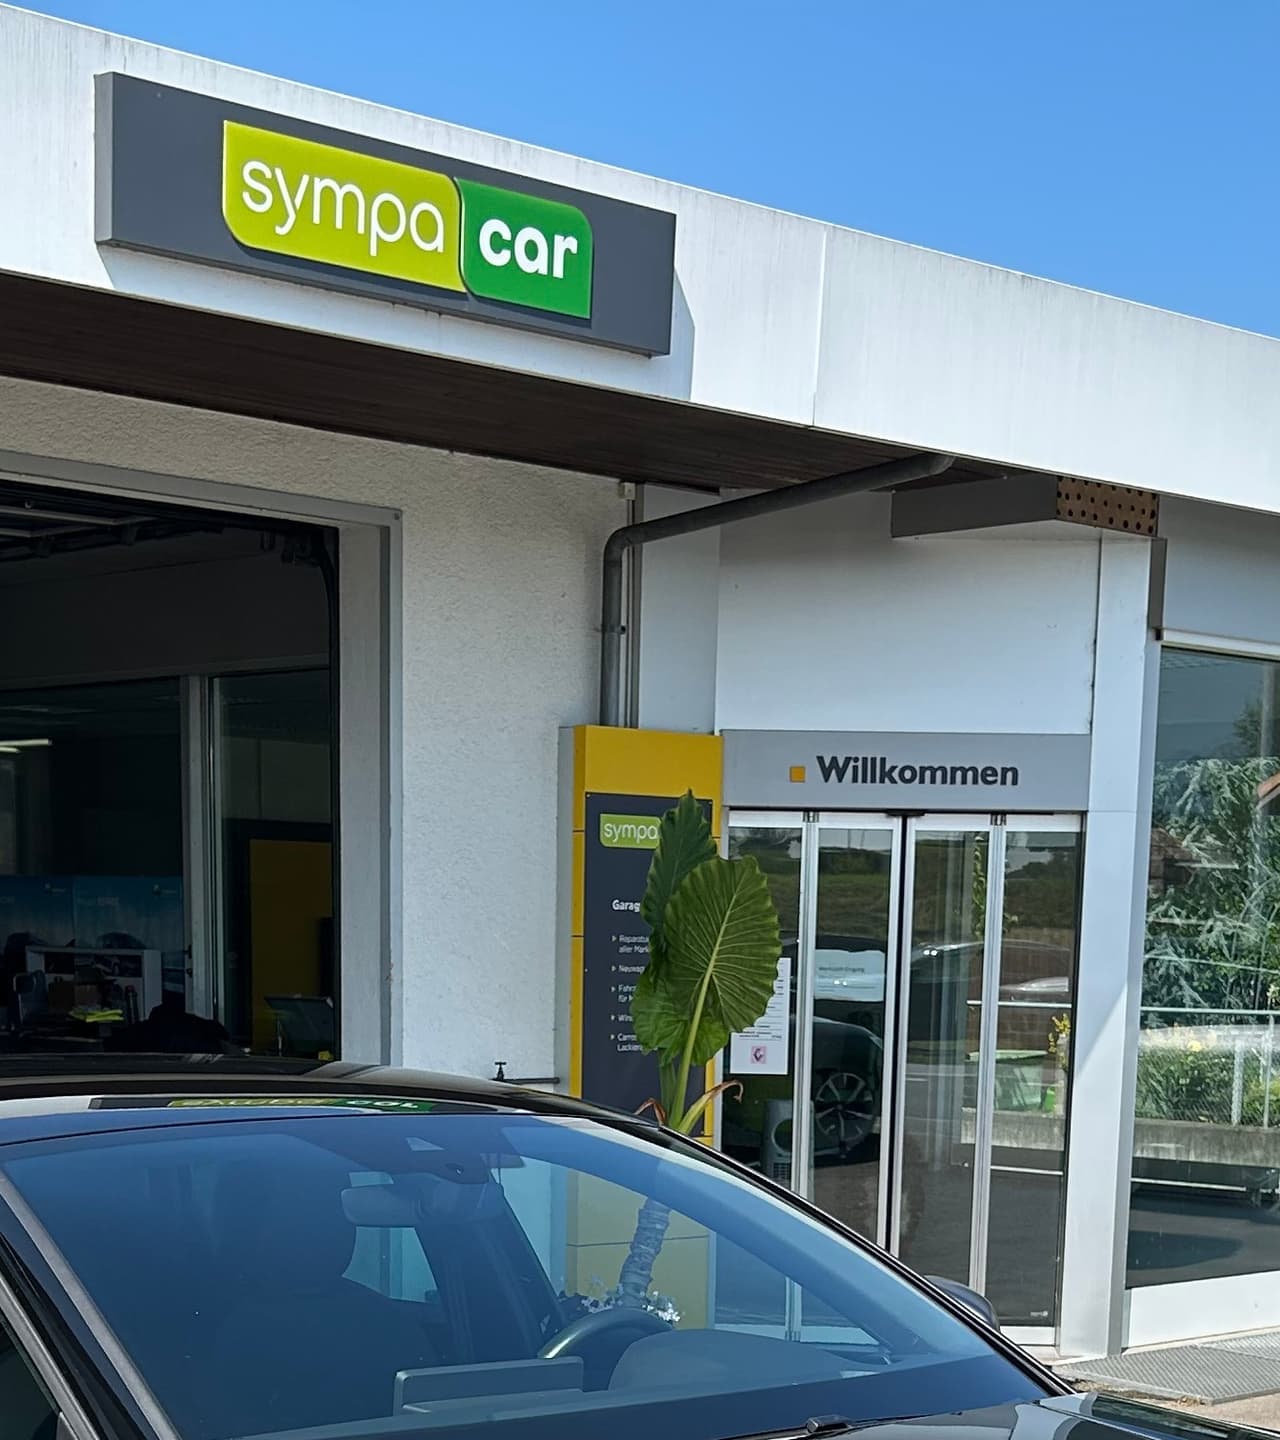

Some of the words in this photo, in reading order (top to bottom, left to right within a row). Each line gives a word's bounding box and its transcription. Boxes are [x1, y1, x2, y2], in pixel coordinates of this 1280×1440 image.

[241, 160, 445, 257] sympa
[478, 218, 579, 279] car
[816, 755, 1019, 786] Willkommen
[604, 823, 658, 844] sympa
[612, 899, 641, 912] Garag
